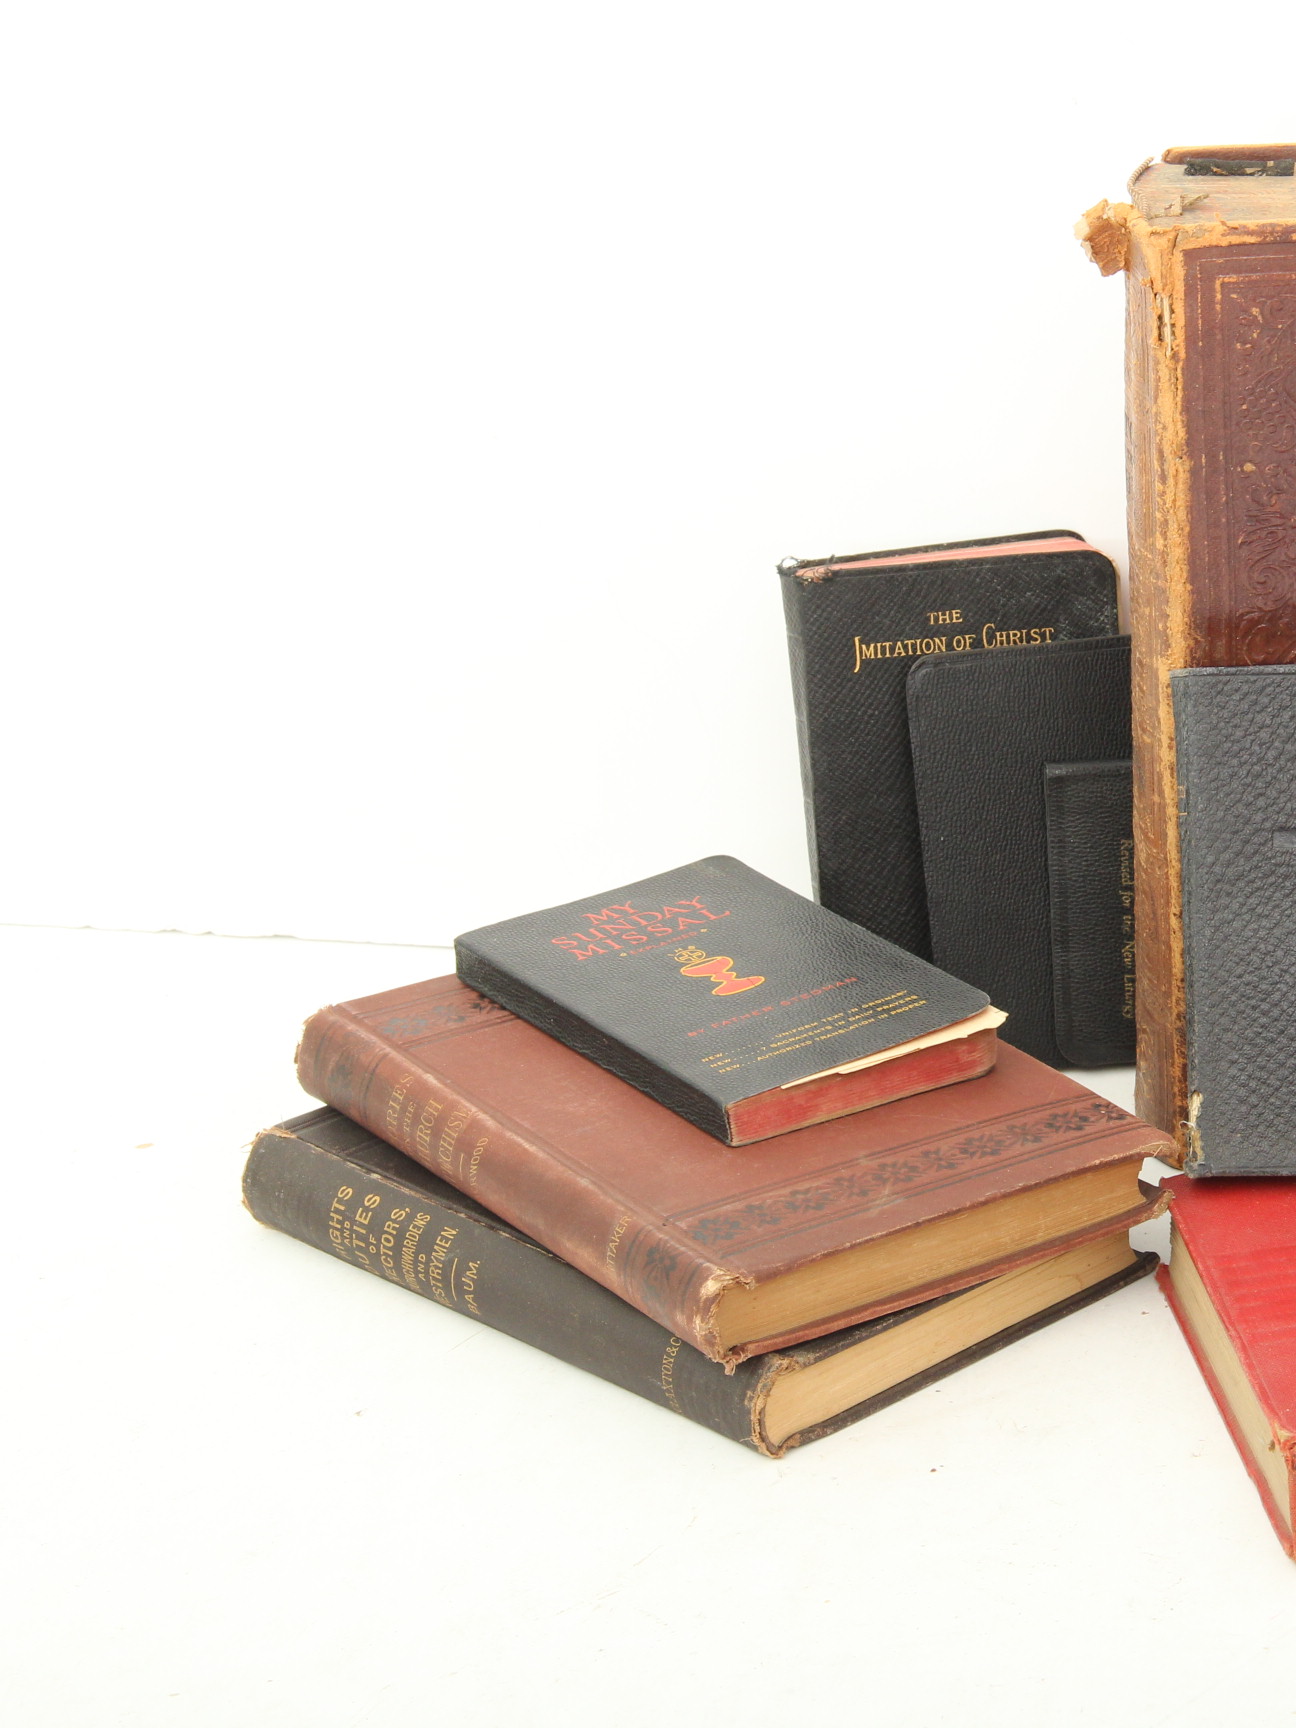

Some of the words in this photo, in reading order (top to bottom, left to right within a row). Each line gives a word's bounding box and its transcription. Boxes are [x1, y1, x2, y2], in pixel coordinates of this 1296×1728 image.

[927, 609, 963, 626] THE
[952, 633, 977, 651] OF
[981, 623, 1055, 650] CHRIST
[1120, 839, 1136, 885] Revised
[581, 900, 638, 925] MY
[1118, 889, 1134, 907] for
[551, 895, 707, 949] SUNDAY
[568, 908, 732, 961] MISSAL
[1122, 914, 1134, 934] the
[1121, 940, 1136, 969] New
[687, 1028, 705, 1037] BY
[710, 1005, 775, 1029] FATHER
[780, 976, 859, 1007] STEDMAN
[1121, 973, 1136, 1019] Liturgy
[701, 1052, 724, 1063] NEW
[821, 1012, 845, 1023] TEXT
[709, 1057, 732, 1069] NEW
[769, 1025, 833, 1049] SACRAMENTS
[848, 1009, 873, 1022] DAILY
[876, 994, 920, 1012] PRAYERS
[718, 1062, 741, 1074] NEW
[756, 1039, 813, 1061] AUTHORIZED
[814, 1017, 876, 1042] TRANSLATION
[877, 1012, 889, 1020] IN
[889, 999, 928, 1016] PROPER
[402, 1101, 417, 1133] THE
[343, 1220, 351, 1247] AND
[369, 1233, 378, 1254] OF
[417, 1253, 426, 1281] AND
